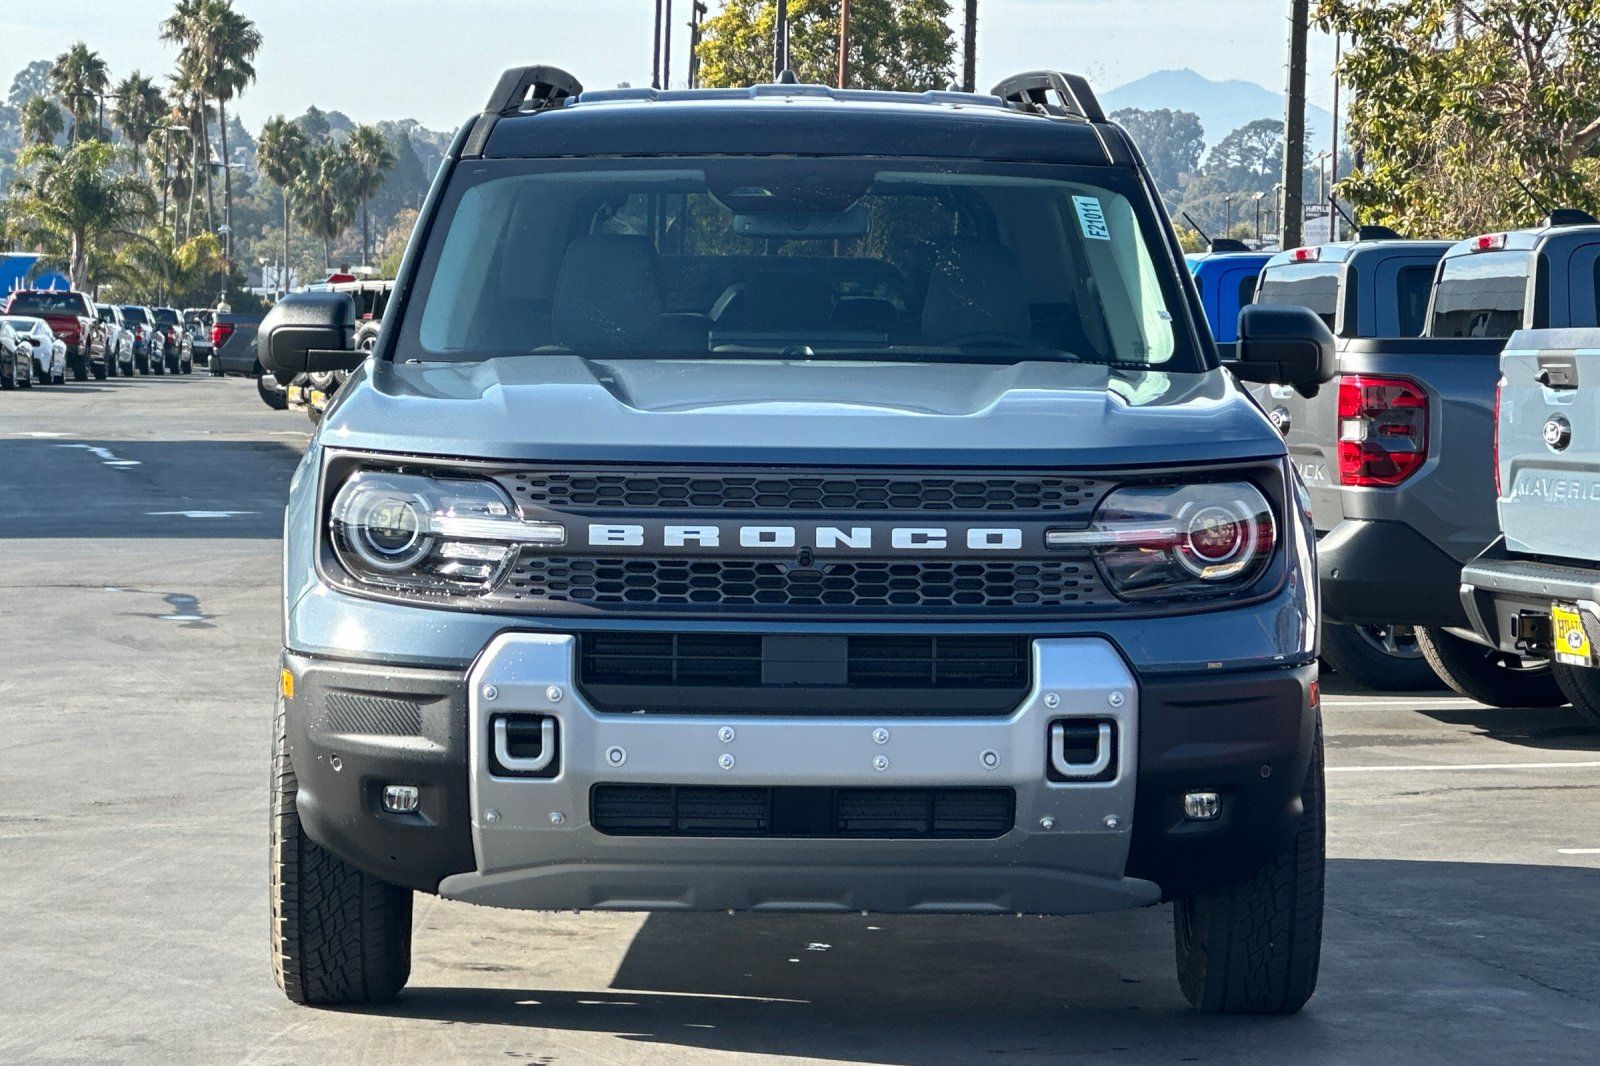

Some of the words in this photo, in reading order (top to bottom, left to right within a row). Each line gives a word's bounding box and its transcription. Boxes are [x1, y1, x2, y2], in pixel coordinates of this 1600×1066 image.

[1080, 202, 1108, 237] F21011
[588, 524, 1022, 549] BRONCO
[1557, 619, 1586, 641] HILLTO
